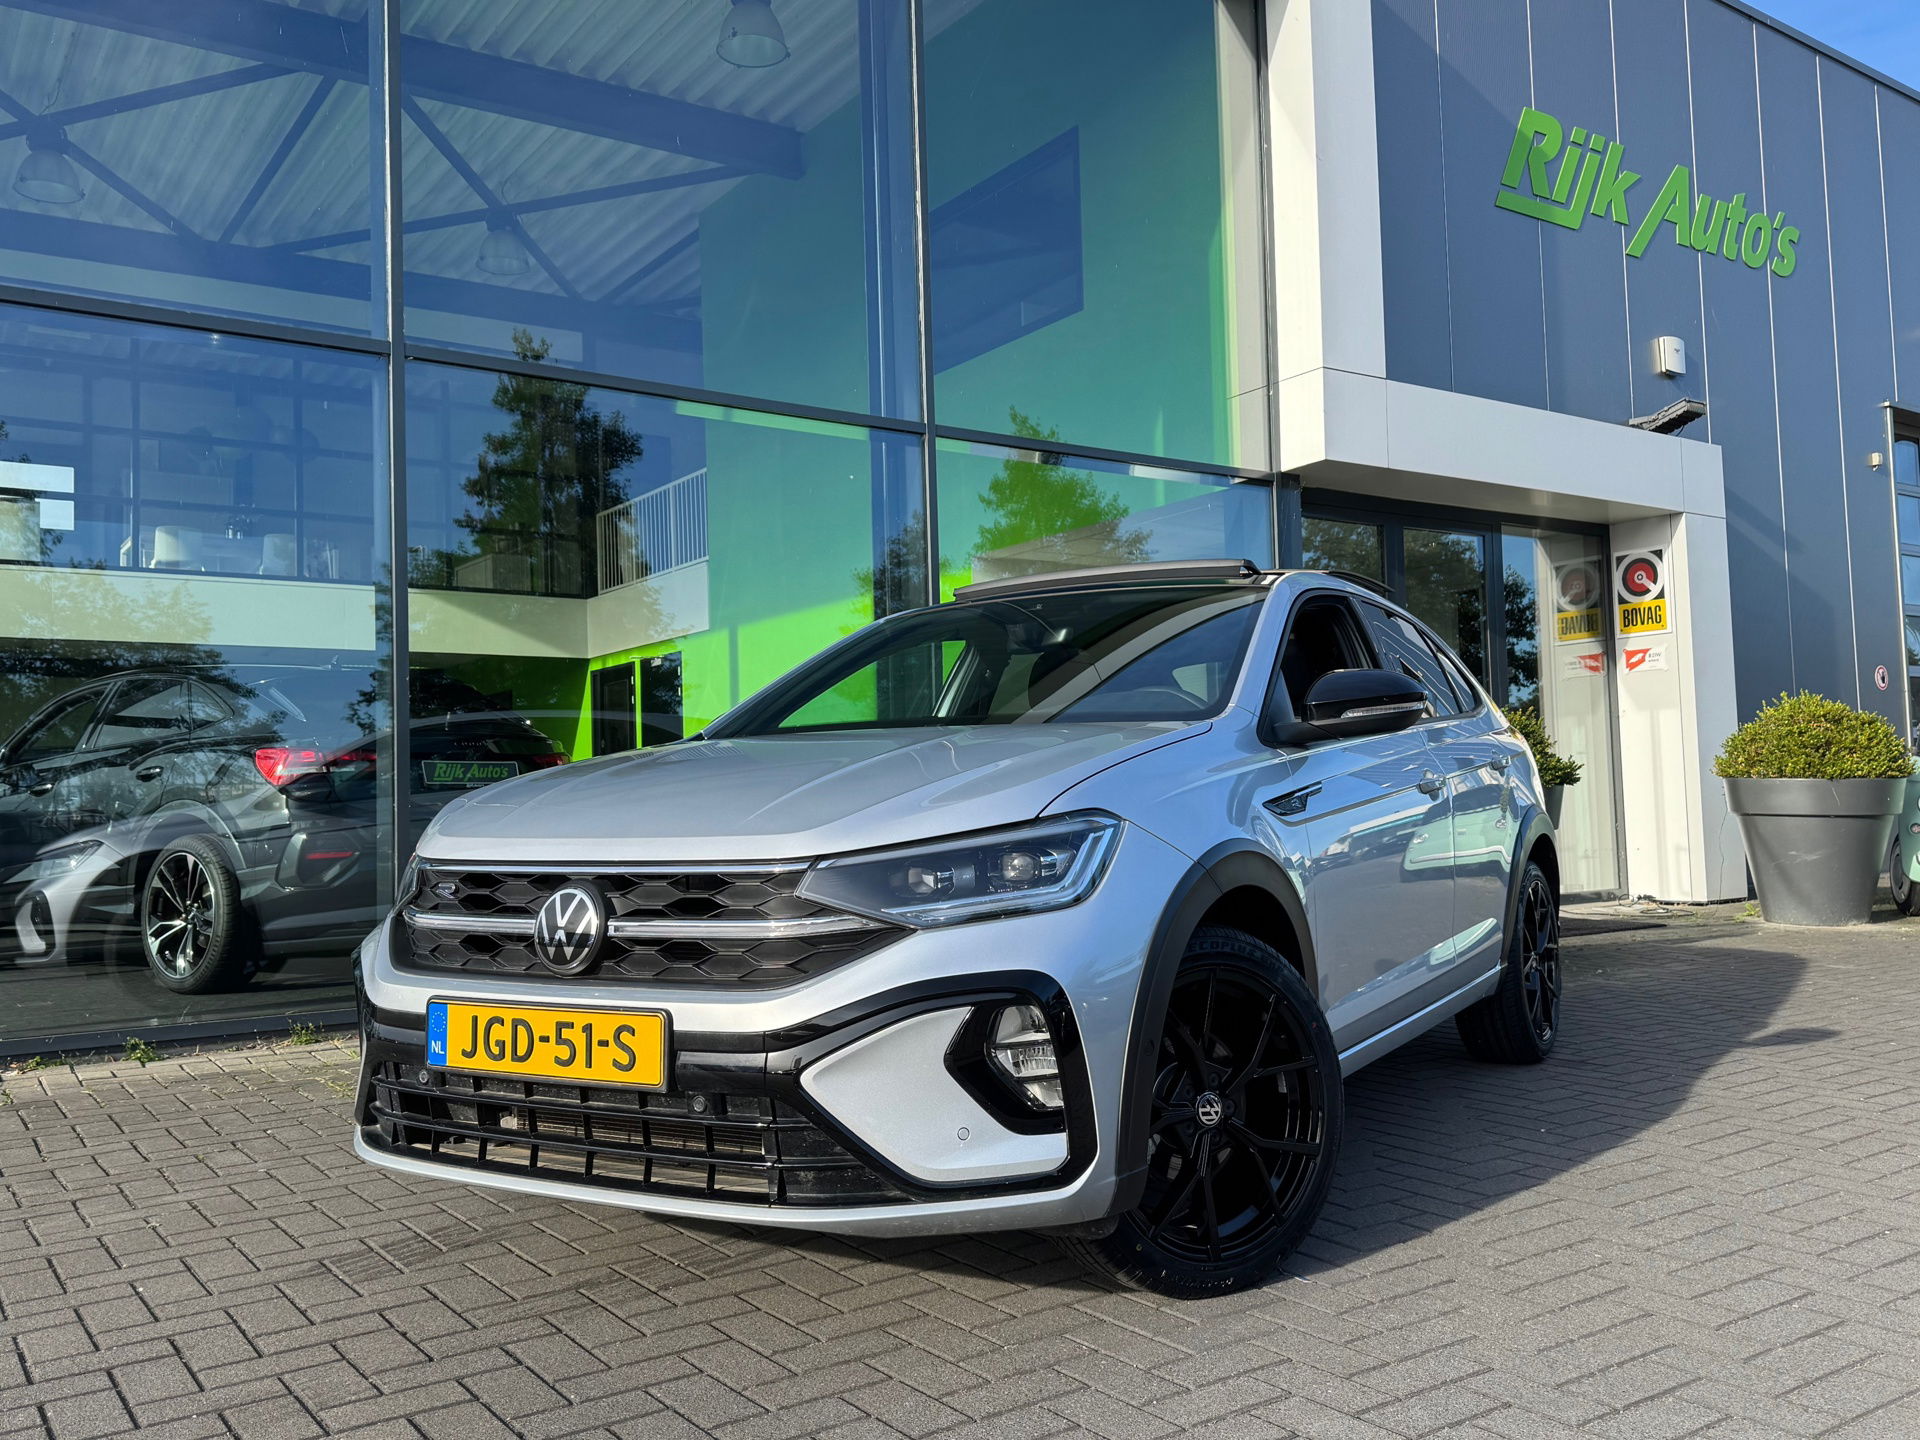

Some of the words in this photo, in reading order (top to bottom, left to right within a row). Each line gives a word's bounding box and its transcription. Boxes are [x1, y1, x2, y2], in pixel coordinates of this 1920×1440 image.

[1495, 106, 1641, 230] Rijk
[1626, 163, 1799, 277] Auto's
[1623, 605, 1662, 628] BOVAG
[433, 763, 464, 781] Rijk
[464, 763, 509, 782] Auto's
[431, 1040, 445, 1055] NL
[461, 1014, 636, 1073] JGD-51-S
